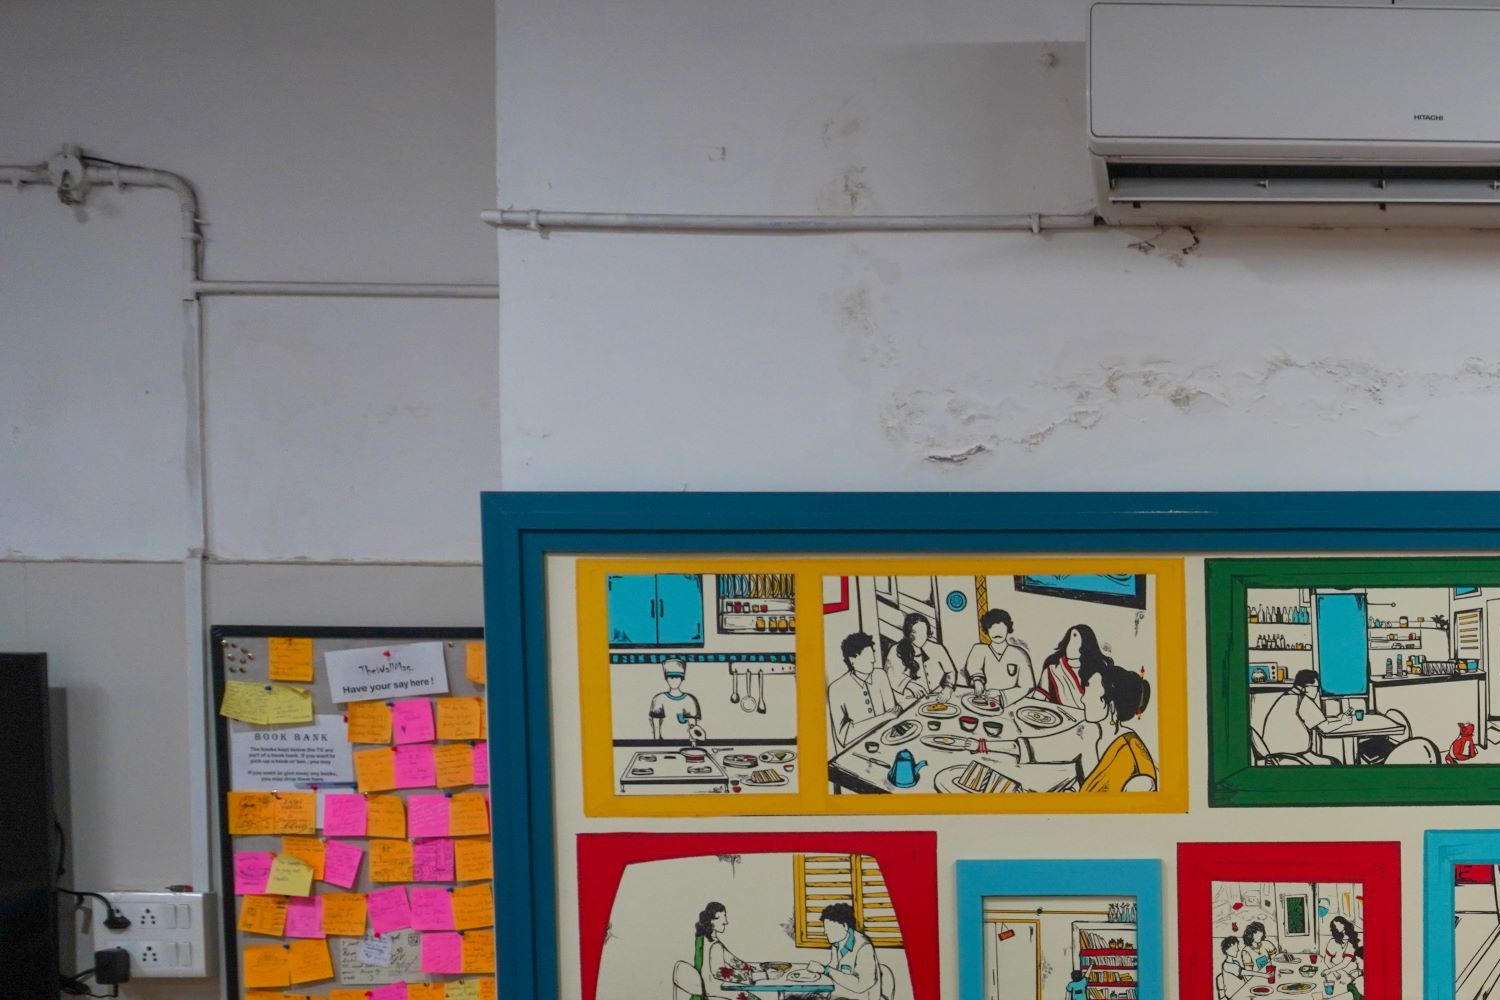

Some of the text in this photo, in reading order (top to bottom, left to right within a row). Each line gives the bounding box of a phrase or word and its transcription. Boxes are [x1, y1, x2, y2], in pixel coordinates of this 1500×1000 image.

[342, 685, 368, 694] Have
[370, 682, 391, 693] your
[393, 680, 408, 689] say
[410, 678, 429, 687] here
[254, 733, 328, 742] BOOK BANK
